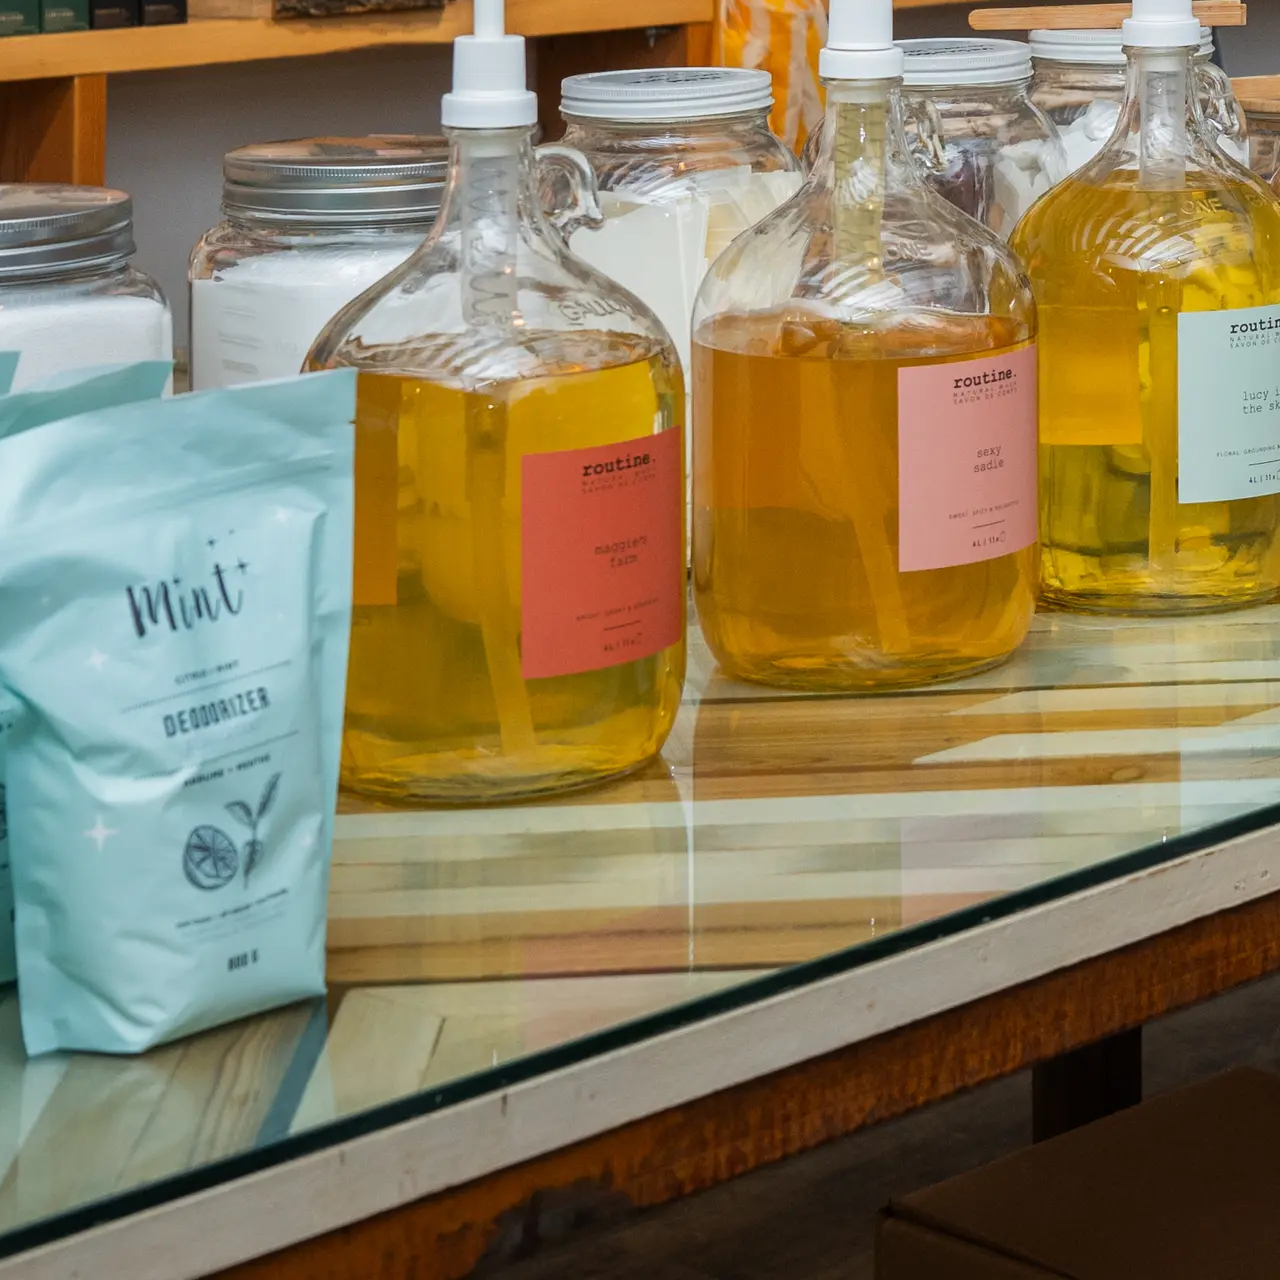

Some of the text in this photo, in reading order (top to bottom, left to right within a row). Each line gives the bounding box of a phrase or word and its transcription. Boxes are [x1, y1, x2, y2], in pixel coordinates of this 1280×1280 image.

[1230, 332, 1271, 343] NATURAL
[1230, 339, 1258, 350] SAVON
[1260, 337, 1272, 347] DE
[953, 368, 1017, 390] routine.
[953, 395, 981, 406] SAVON
[1243, 387, 1269, 402] lucy
[1242, 402, 1263, 416] the
[976, 443, 1002, 459] sexy
[582, 452, 657, 477] routine.
[973, 456, 1005, 473] sadie
[125, 562, 243, 638] Mint
[162, 685, 272, 739] DEODORIZER
